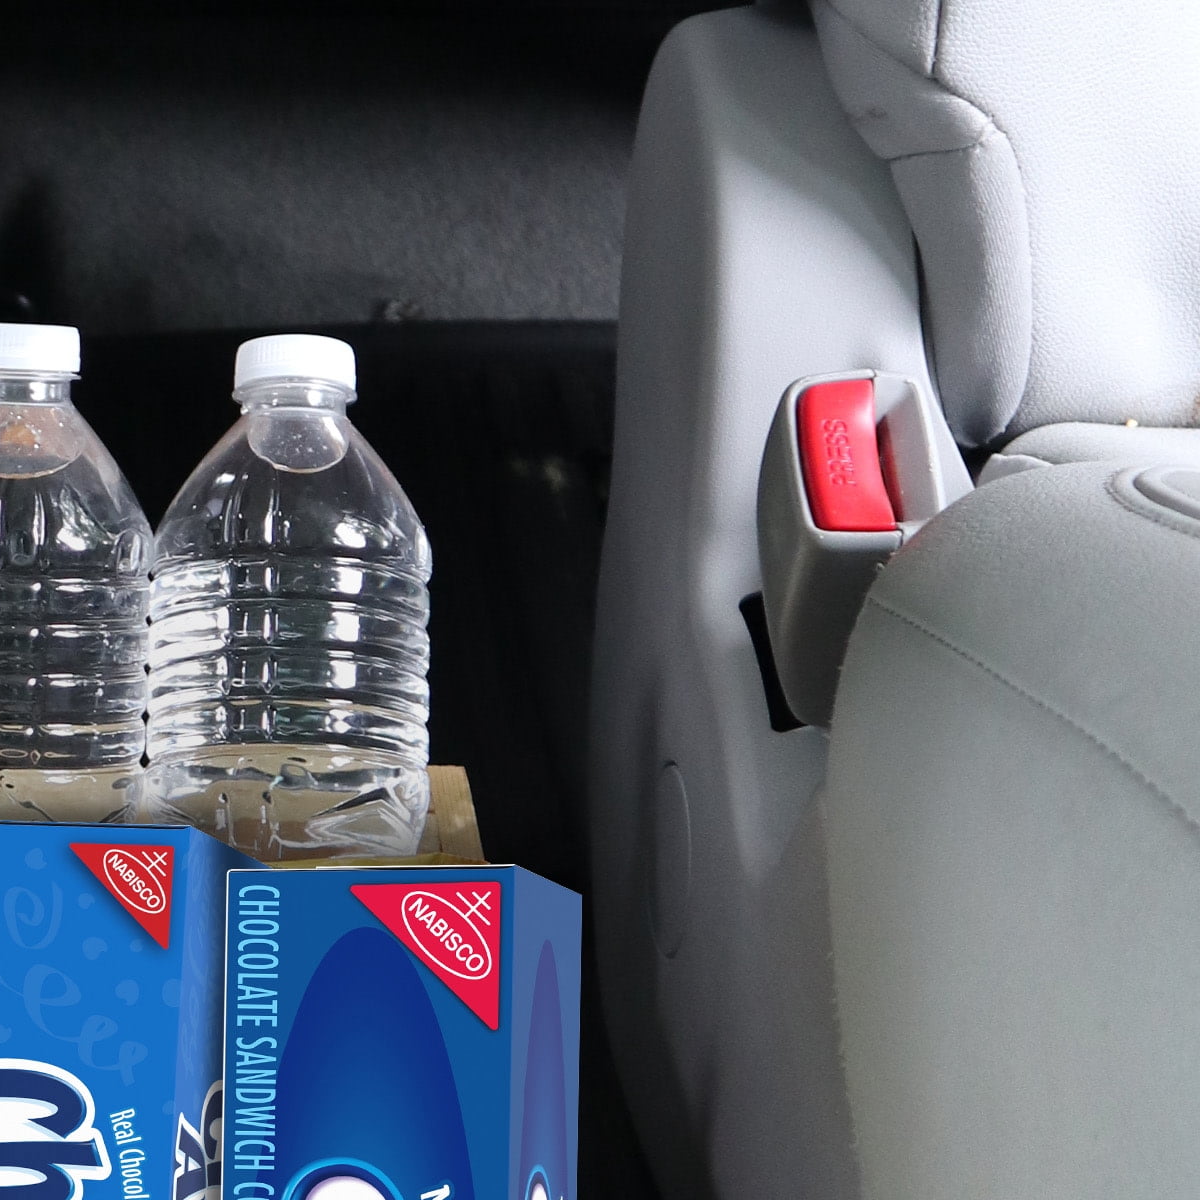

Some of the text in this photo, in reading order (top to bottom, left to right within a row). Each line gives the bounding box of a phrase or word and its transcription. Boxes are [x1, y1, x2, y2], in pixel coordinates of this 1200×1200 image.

[821, 418, 857, 487] PRESS
[106, 852, 161, 910] NABISCO
[235, 884, 281, 1027] CHOCOLATE
[407, 897, 485, 973] NABISCO
[109, 1108, 135, 1145] Real
[233, 1036, 278, 1171] SANDWICH
